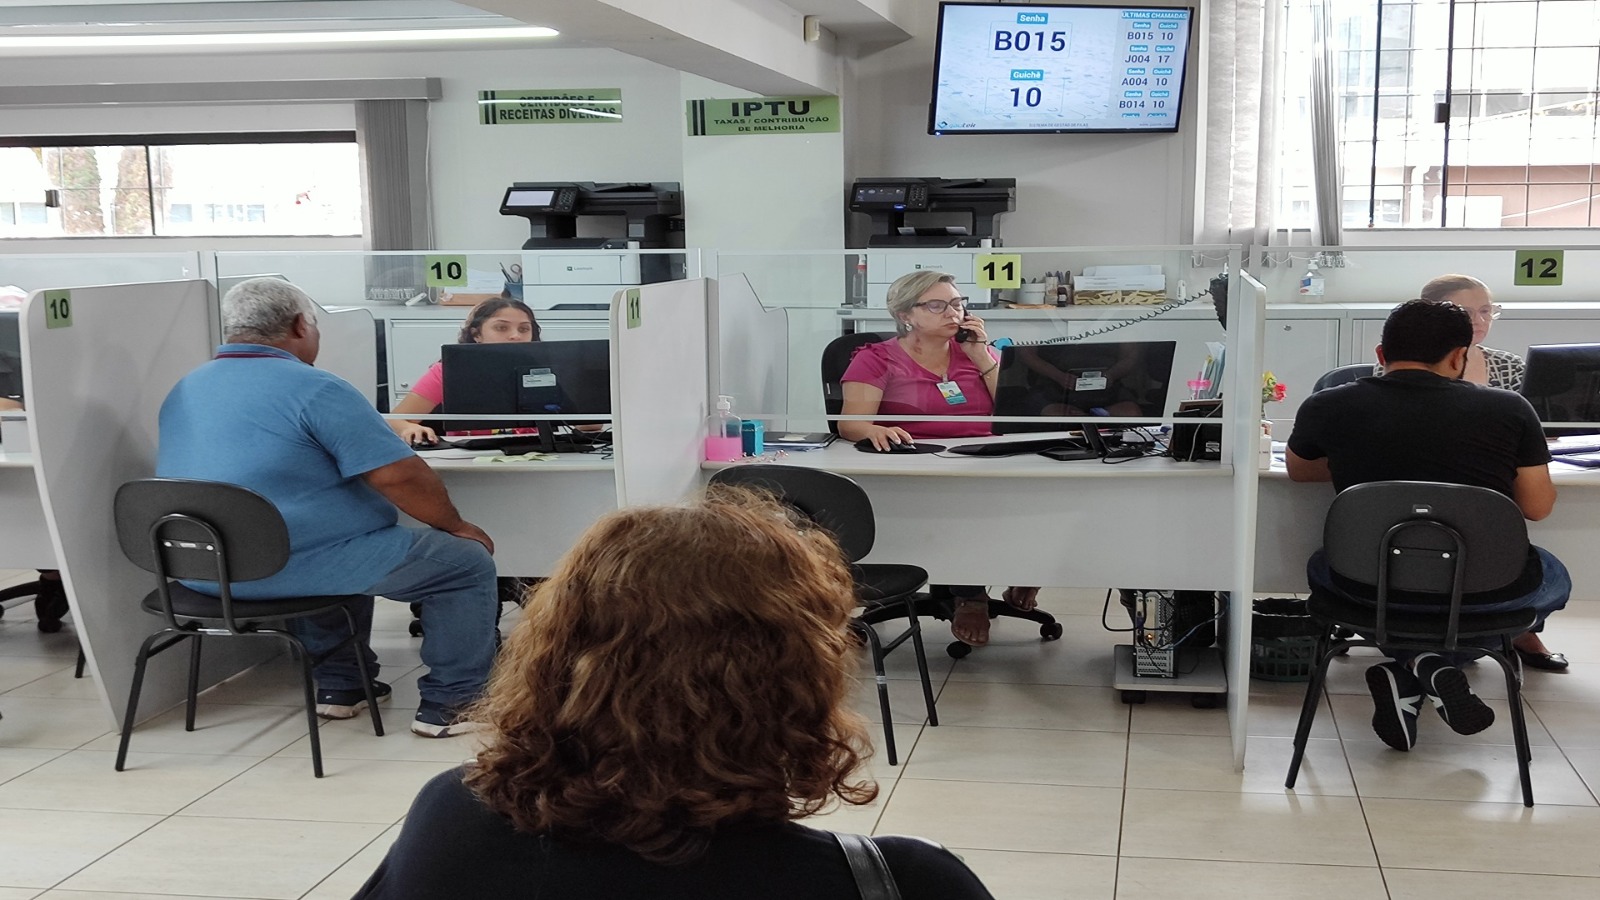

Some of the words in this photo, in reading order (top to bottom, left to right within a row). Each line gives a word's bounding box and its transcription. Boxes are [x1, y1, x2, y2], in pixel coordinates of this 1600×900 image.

[1020, 14, 1046, 22] Senha
[994, 30, 1066, 52] B015
[1127, 31, 1154, 40] B015
[1162, 32, 1174, 40] 10
[1124, 55, 1150, 63] J004
[1158, 55, 1170, 63] 17
[1013, 71, 1041, 79] Guichê
[1121, 77, 1148, 86] A004
[1156, 77, 1168, 86] 10
[1010, 87, 1042, 107] 10
[731, 100, 810, 117] IPTU
[1119, 100, 1145, 109] B014
[1153, 100, 1165, 109] 10
[500, 108, 555, 120] RECEITAS
[754, 116, 829, 124] CONTRIBUIÇÃO
[753, 124, 806, 132] MELHORIA
[430, 261, 462, 280] 10
[982, 262, 1014, 280] 11
[1520, 257, 1558, 279] 12
[49, 298, 71, 321] 10
[630, 296, 640, 320] 11
